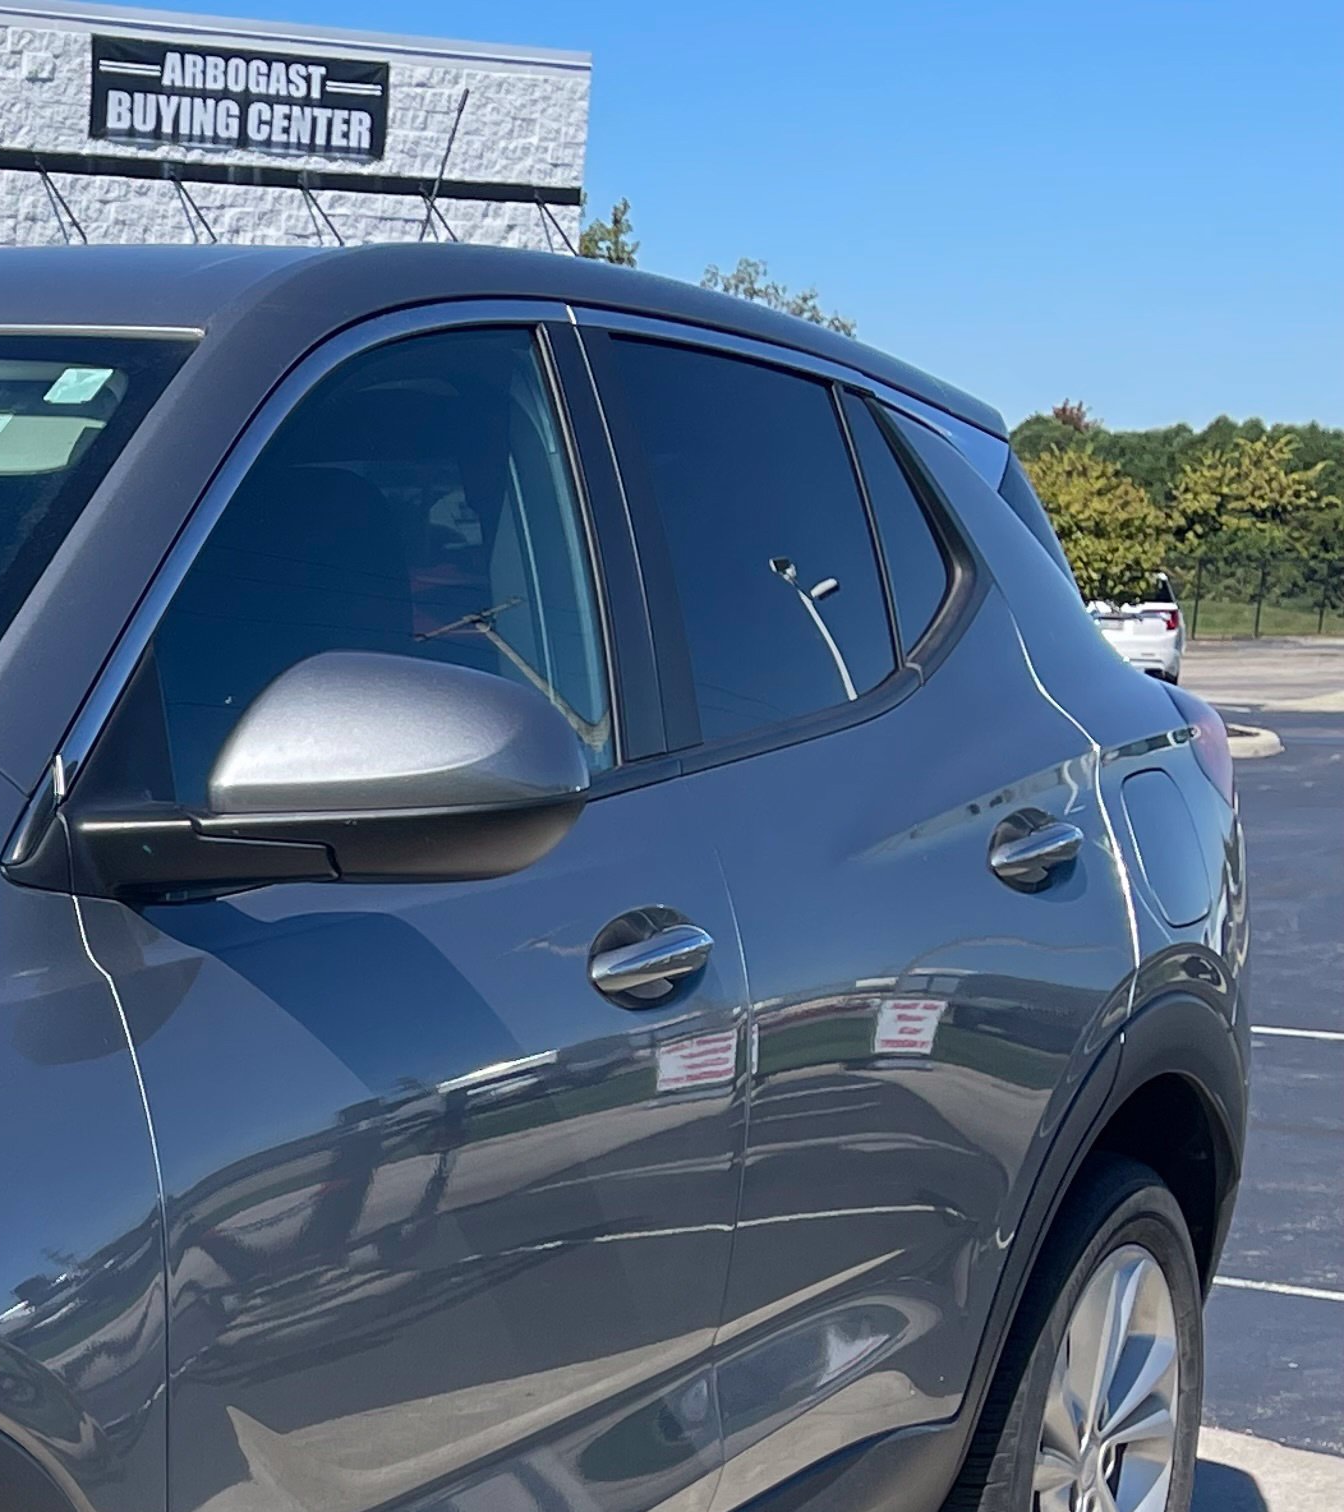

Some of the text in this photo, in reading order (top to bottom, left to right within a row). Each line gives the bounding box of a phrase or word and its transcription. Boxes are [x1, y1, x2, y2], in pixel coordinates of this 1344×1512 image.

[161, 51, 327, 100] ARBOGAST
[106, 89, 373, 149] BUYING CENTER
